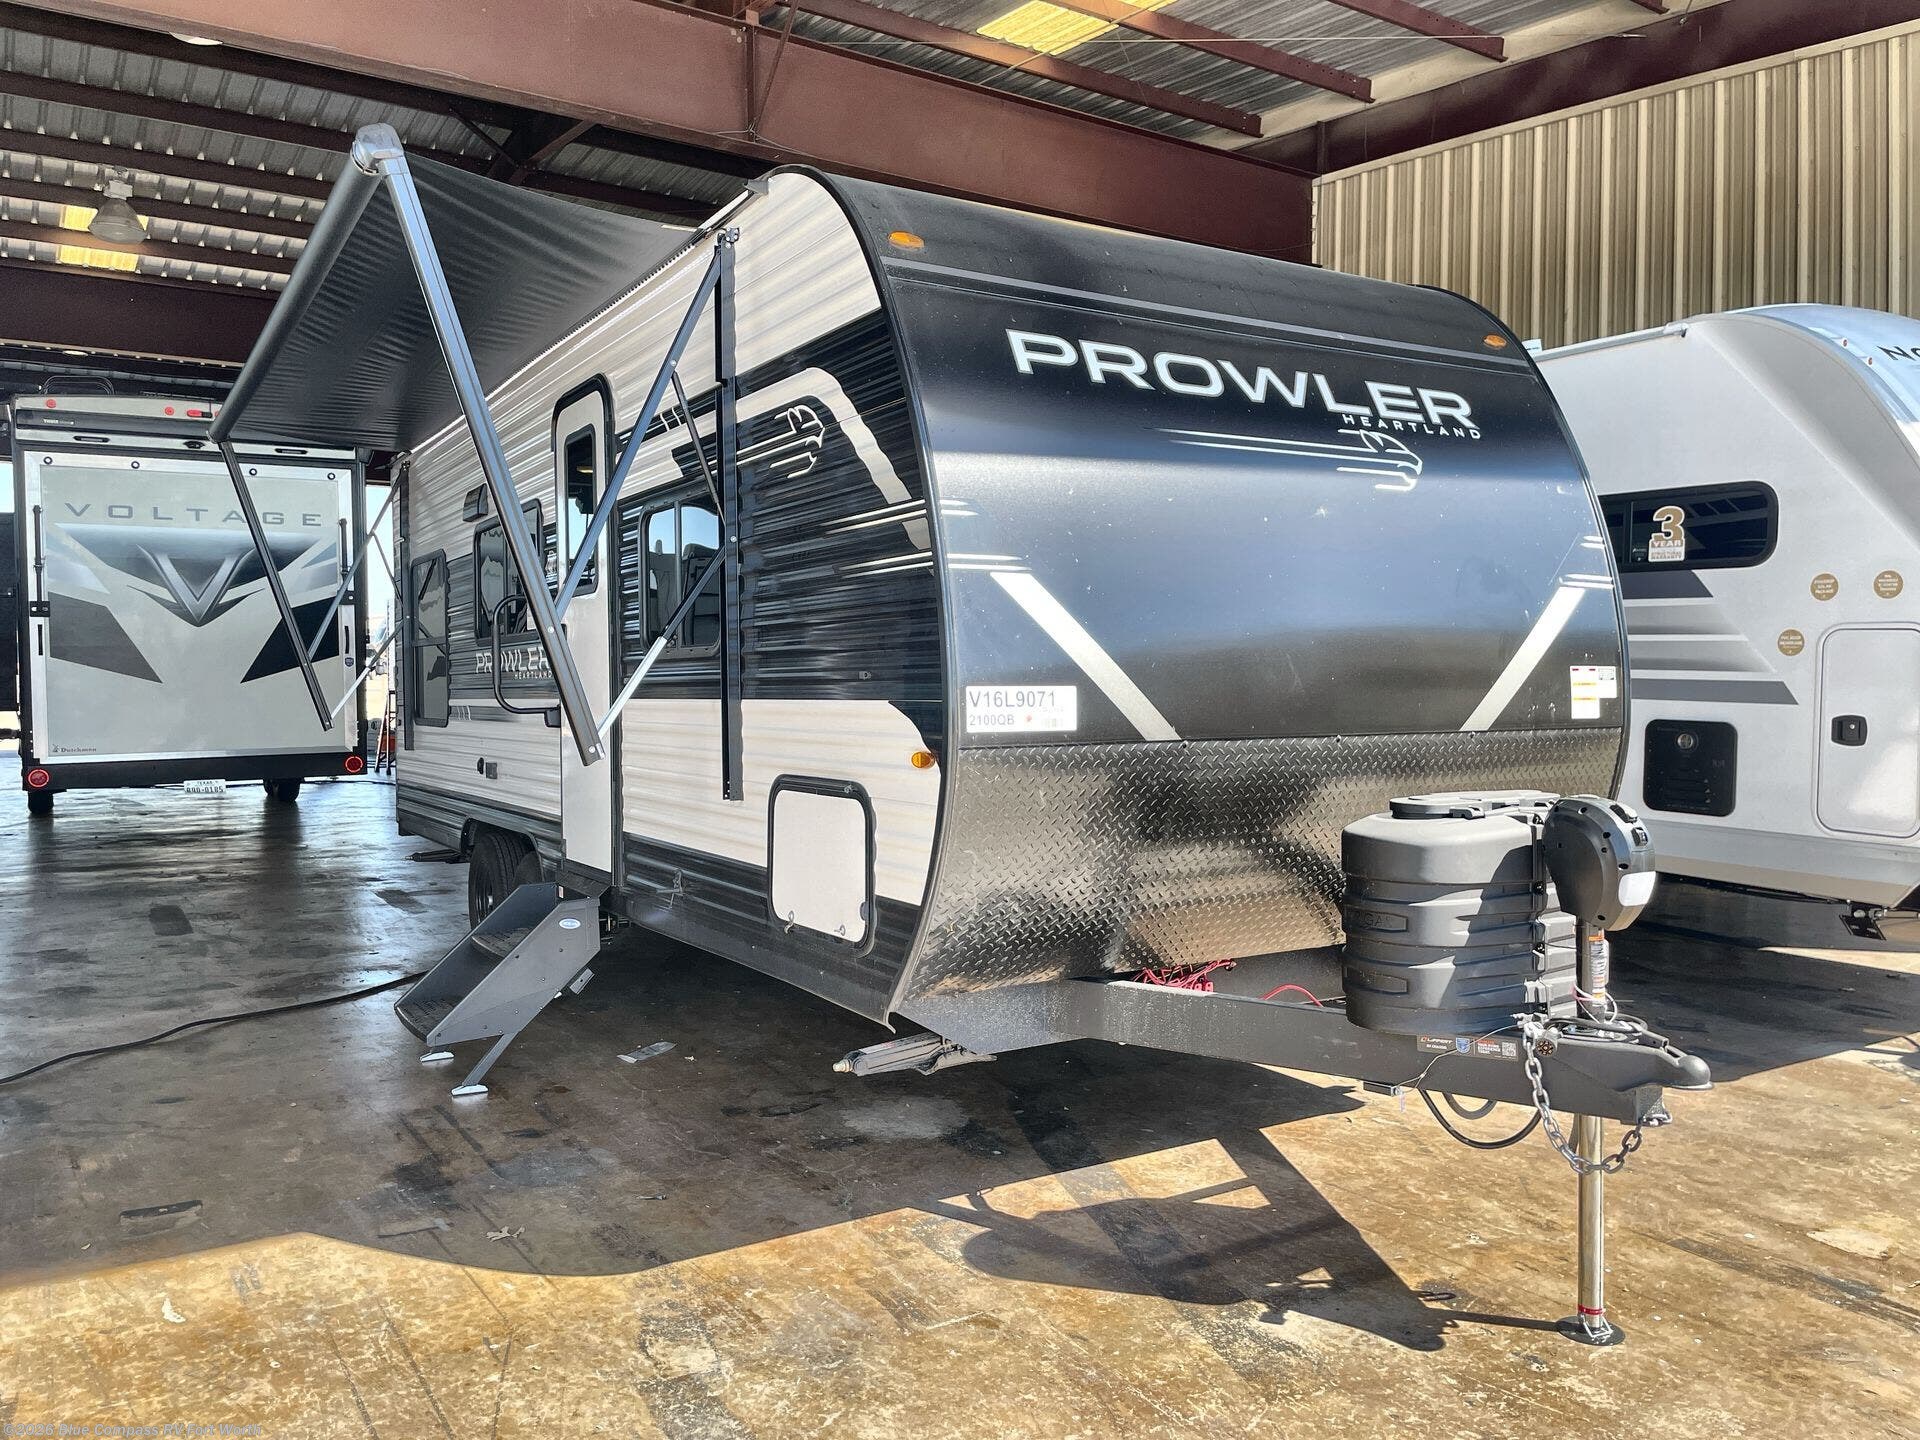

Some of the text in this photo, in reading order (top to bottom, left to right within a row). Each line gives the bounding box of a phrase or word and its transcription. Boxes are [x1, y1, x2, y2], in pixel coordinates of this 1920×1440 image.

[1005, 328, 1480, 430] PROWLER
[1342, 413, 1481, 440] HEARTLAND
[64, 502, 322, 527] VOLTAGE
[1652, 505, 1684, 540] 3
[475, 646, 551, 674] PRWLER
[514, 670, 553, 680] HEARTLAND
[968, 690, 1056, 708] V16L9071
[969, 713, 1015, 726] 2100QB
